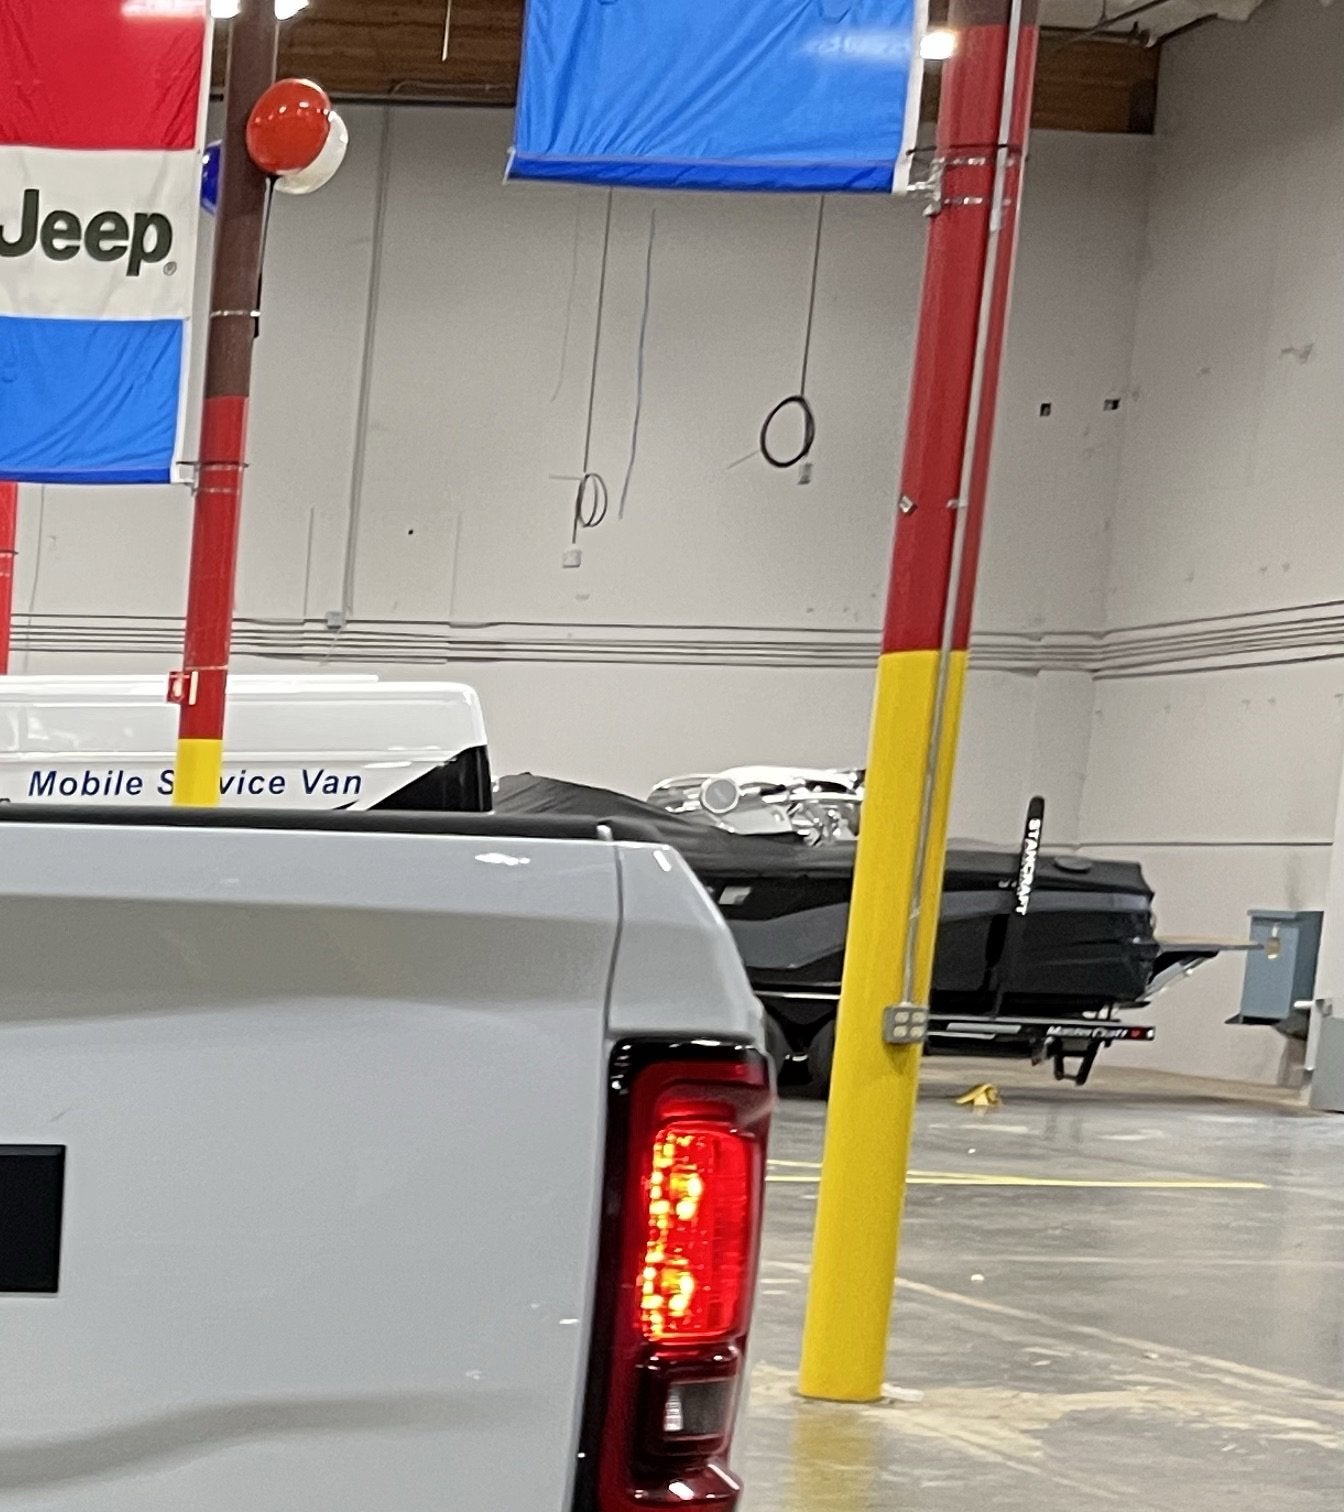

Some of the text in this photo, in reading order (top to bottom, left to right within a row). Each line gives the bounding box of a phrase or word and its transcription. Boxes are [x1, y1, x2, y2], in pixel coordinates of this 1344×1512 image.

[28, 769, 362, 797] Mobile Svice Van
